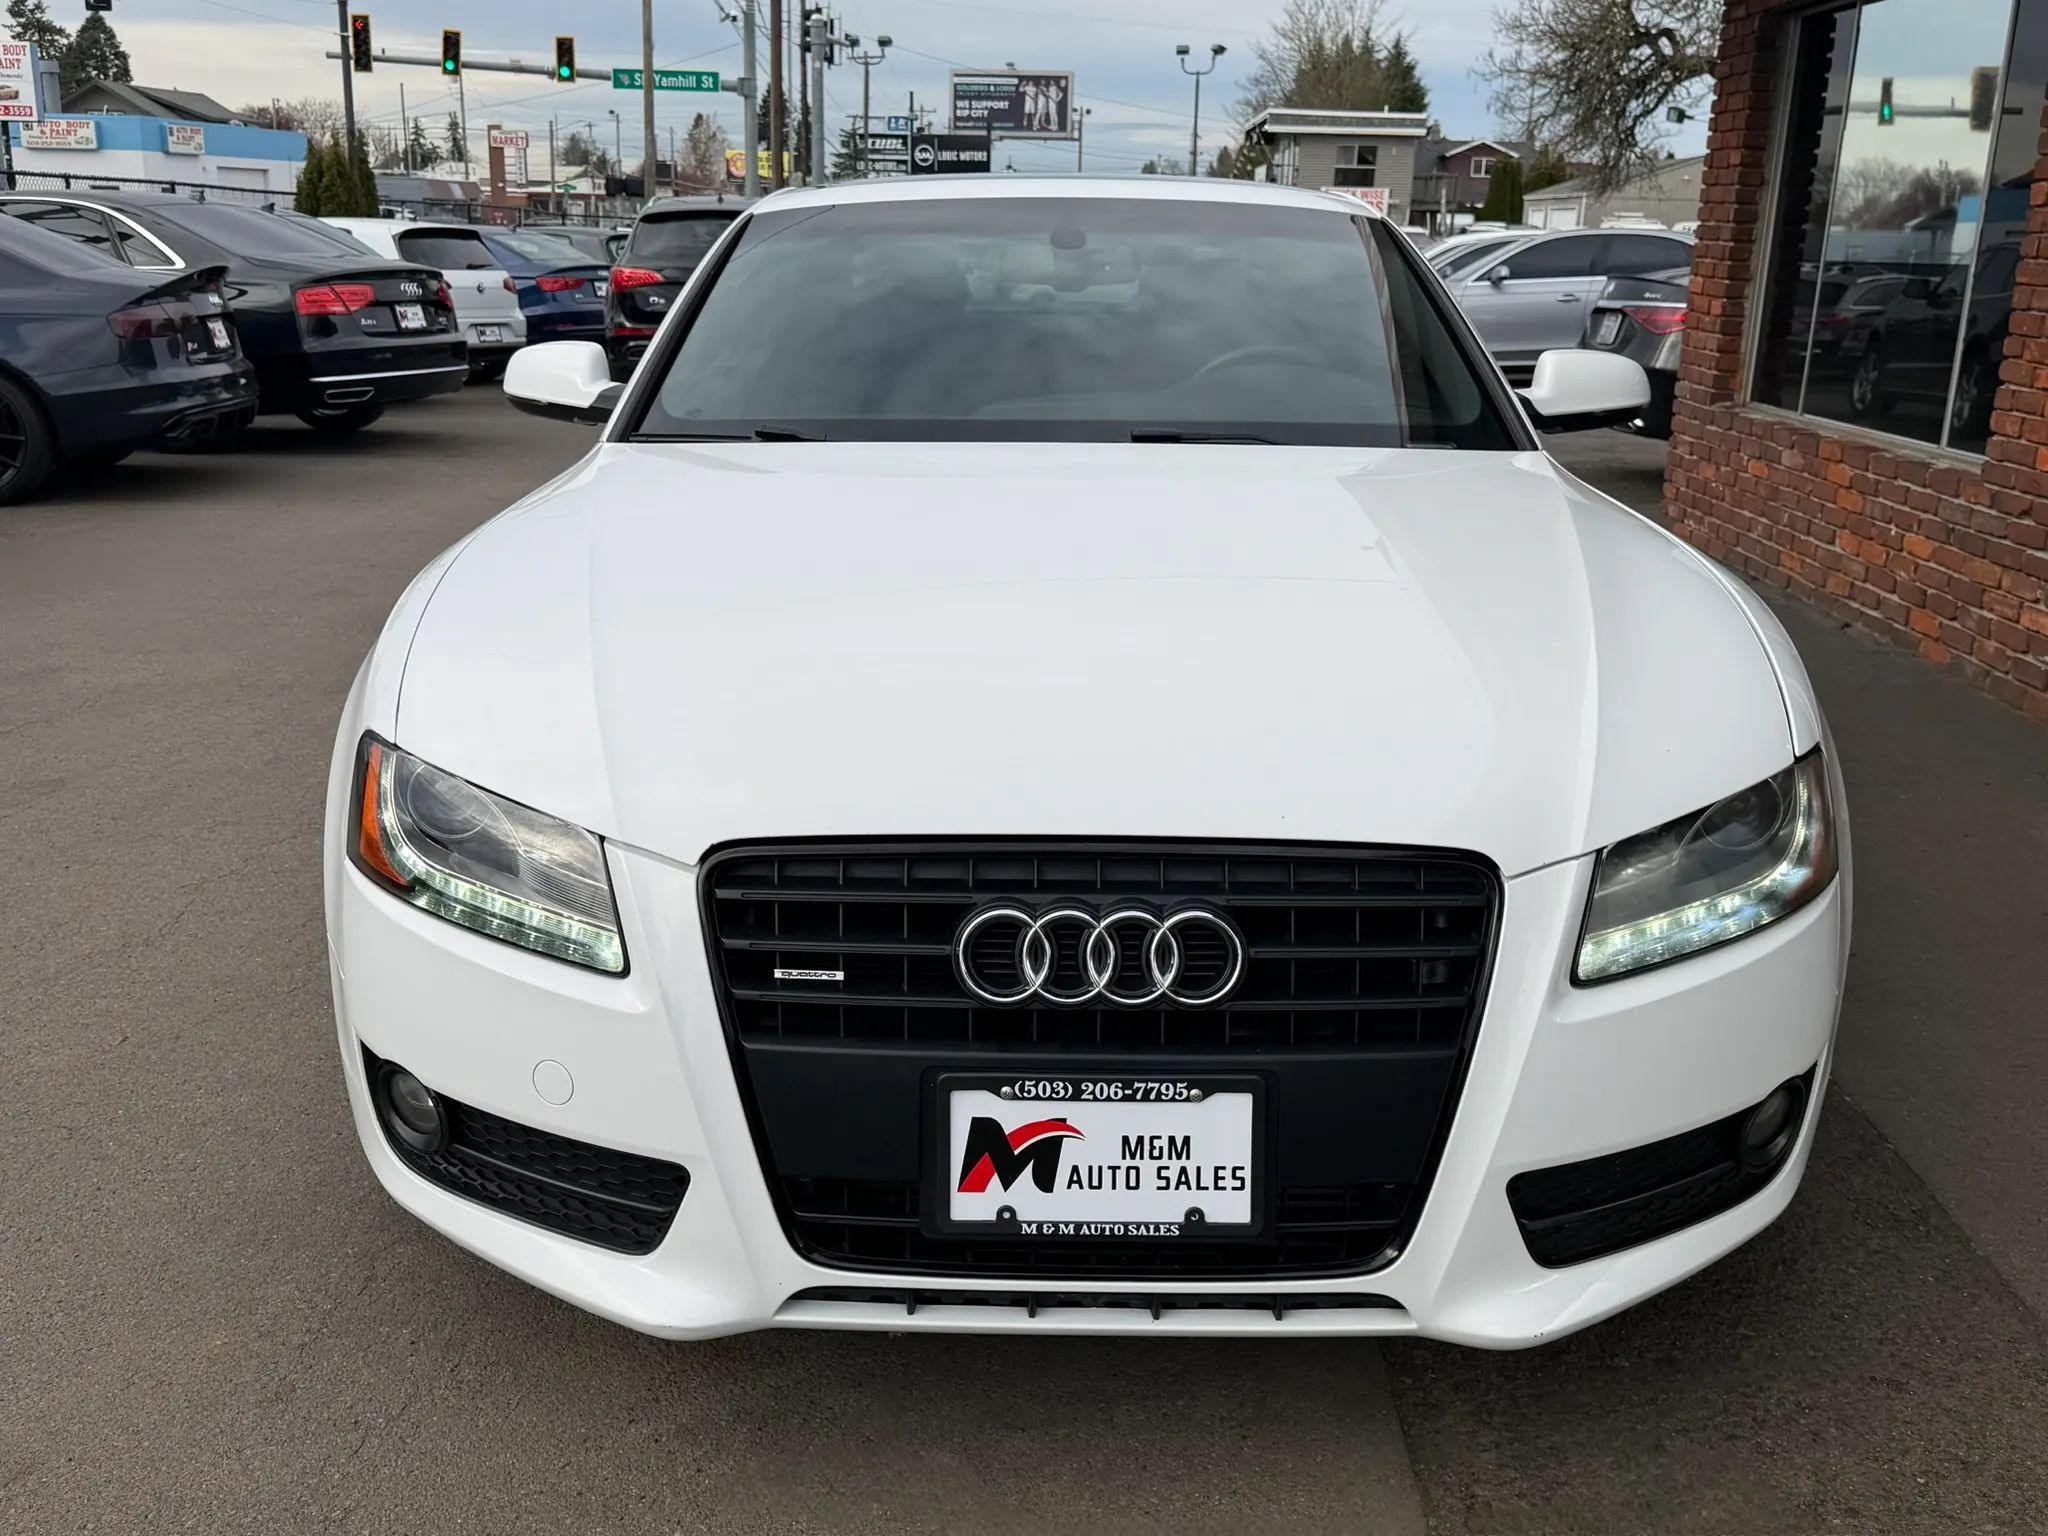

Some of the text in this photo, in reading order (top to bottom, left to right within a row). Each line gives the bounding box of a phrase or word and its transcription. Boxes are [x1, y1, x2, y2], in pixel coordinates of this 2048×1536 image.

[3, 44, 27, 56] BODY
[653, 74, 696, 88] Yamhill
[701, 77, 713, 88] St
[971, 101, 1009, 109] SUPPORT
[492, 135, 525, 146] MARKET
[938, 151, 957, 161] LOGIC
[958, 151, 987, 162] MOTORS
[1012, 1080, 1189, 1100] (503) 206-7795
[1120, 1135, 1191, 1161] M&M
[1066, 1165, 1246, 1191] AUTO SALES
[1020, 1224, 1180, 1236] M & M AUTO SALES
